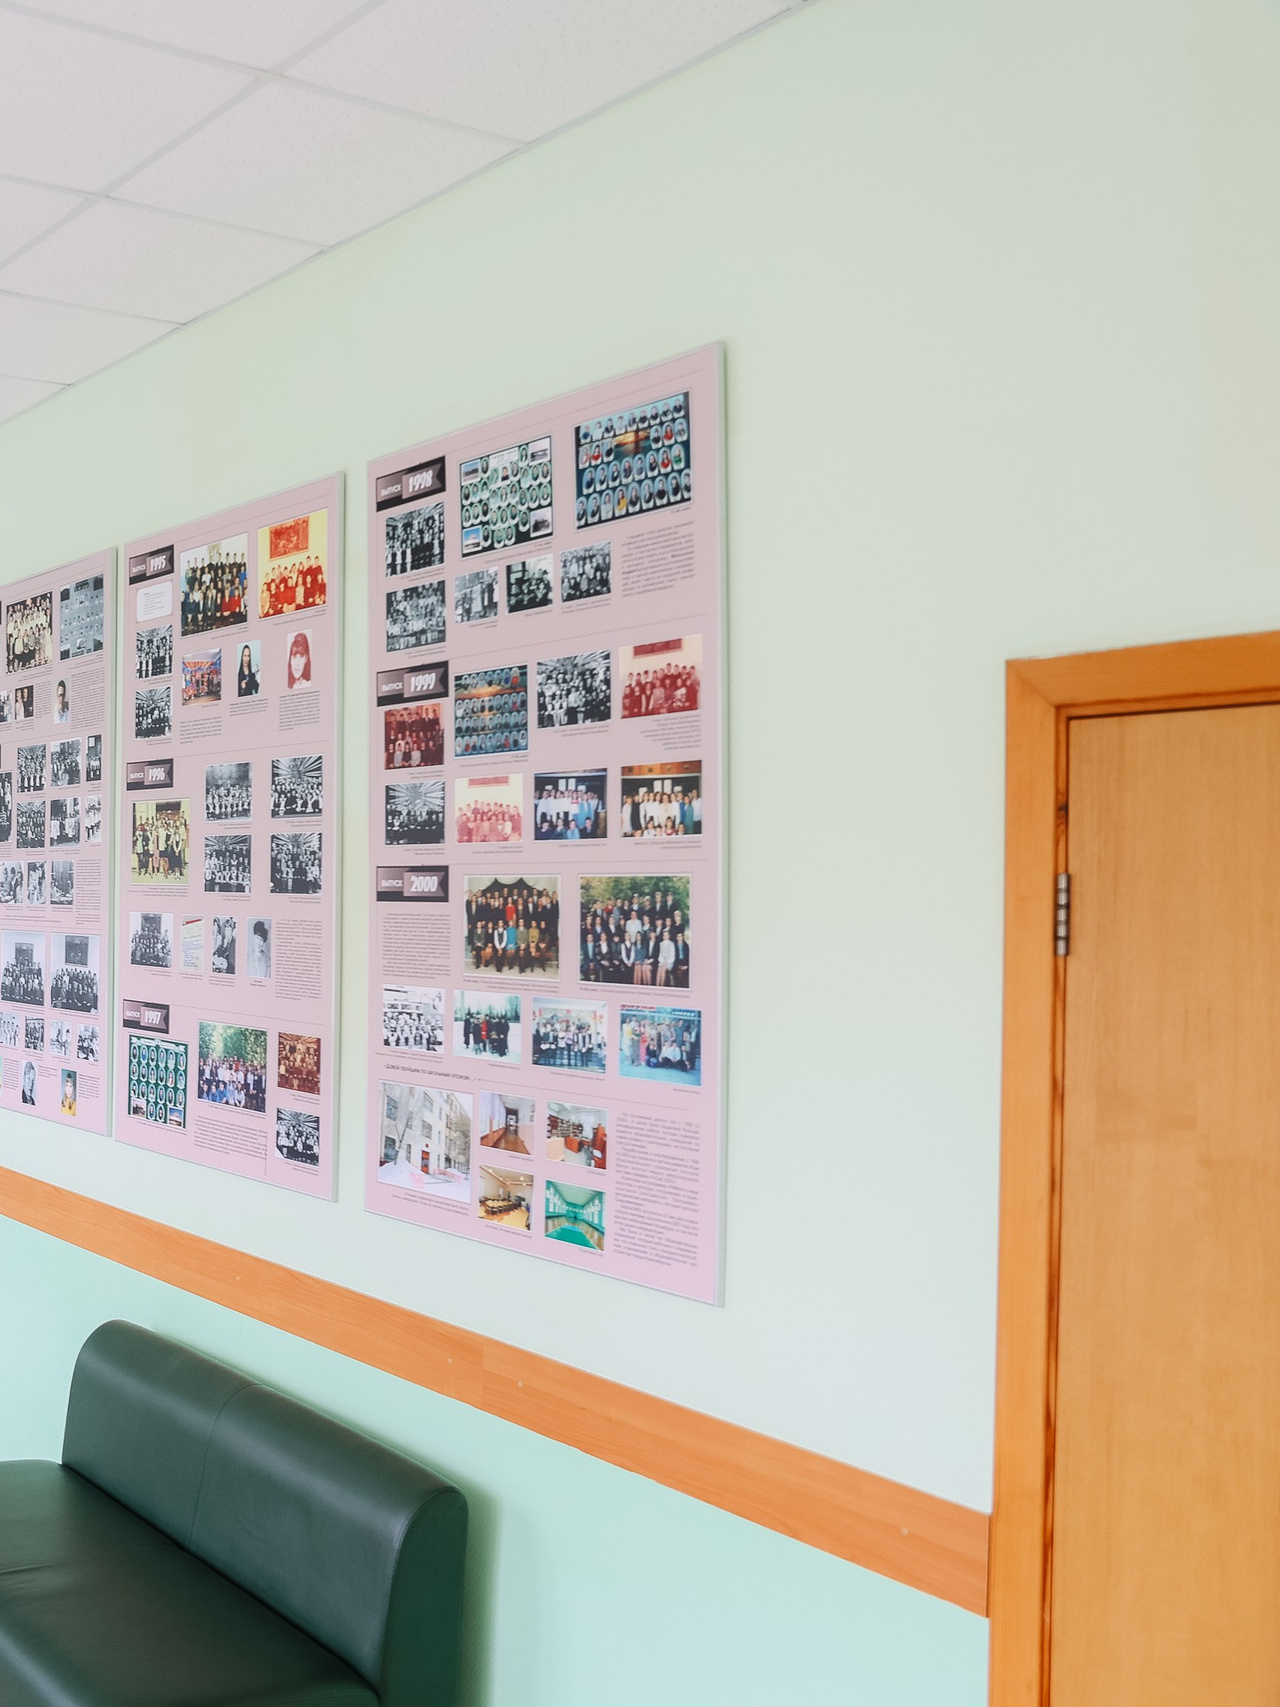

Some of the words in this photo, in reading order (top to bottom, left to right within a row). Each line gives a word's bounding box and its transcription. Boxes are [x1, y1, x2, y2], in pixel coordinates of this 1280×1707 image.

[408, 469, 433, 493] 1998
[150, 555, 167, 572] 1995
[410, 672, 436, 692] 1999
[148, 767, 165, 781] 1996
[410, 875, 438, 892] 2000
[144, 1010, 162, 1025] 1997
